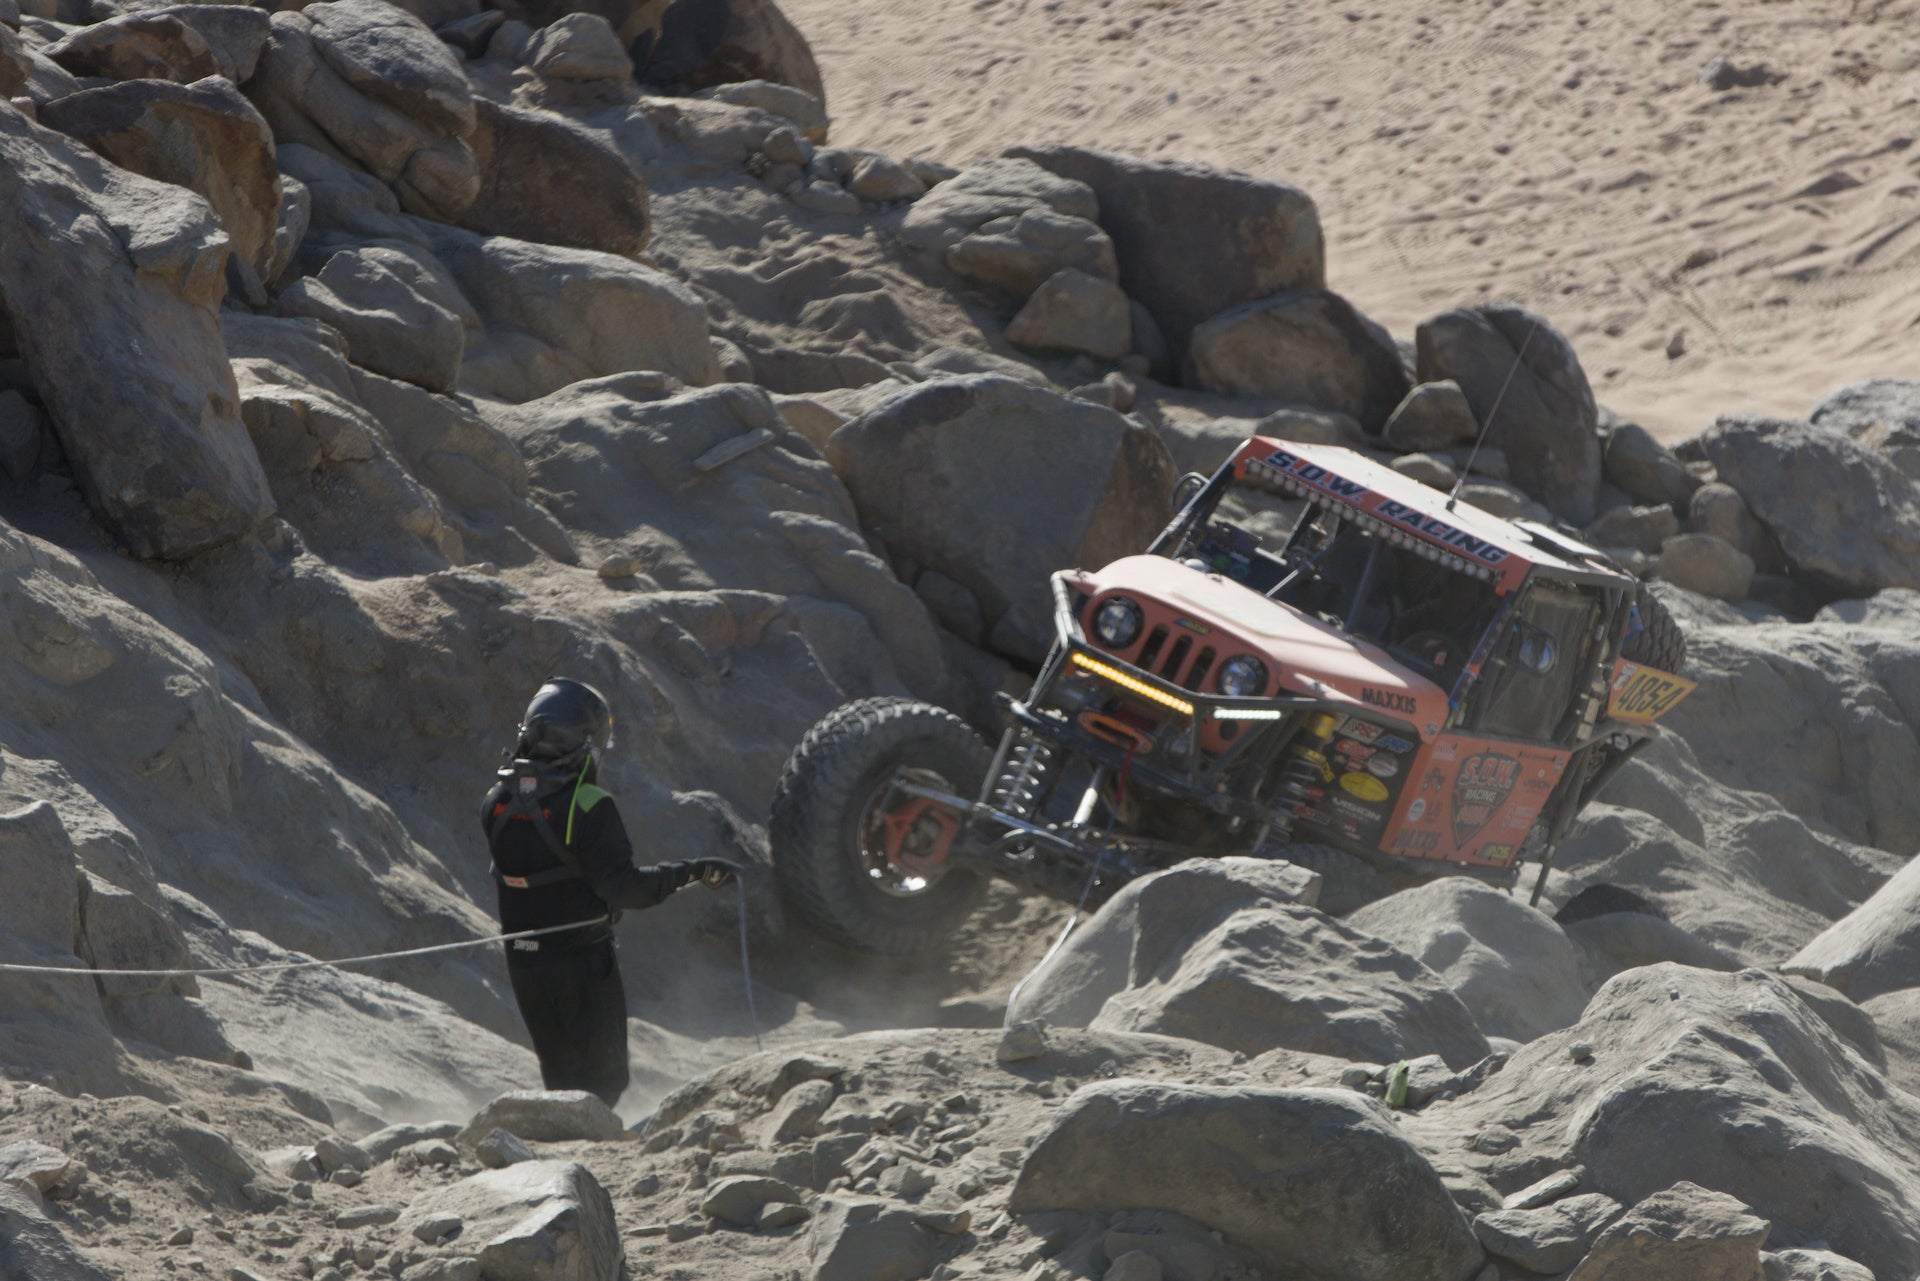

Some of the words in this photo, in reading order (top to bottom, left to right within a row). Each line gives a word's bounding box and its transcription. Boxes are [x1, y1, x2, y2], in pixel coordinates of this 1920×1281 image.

[1374, 499, 1510, 565] RACING
[1362, 687, 1417, 715] MAXXIS
[1464, 789, 1497, 803] RACING
[1332, 797, 1381, 821] VISION
[512, 938, 540, 952] SIMPSON
